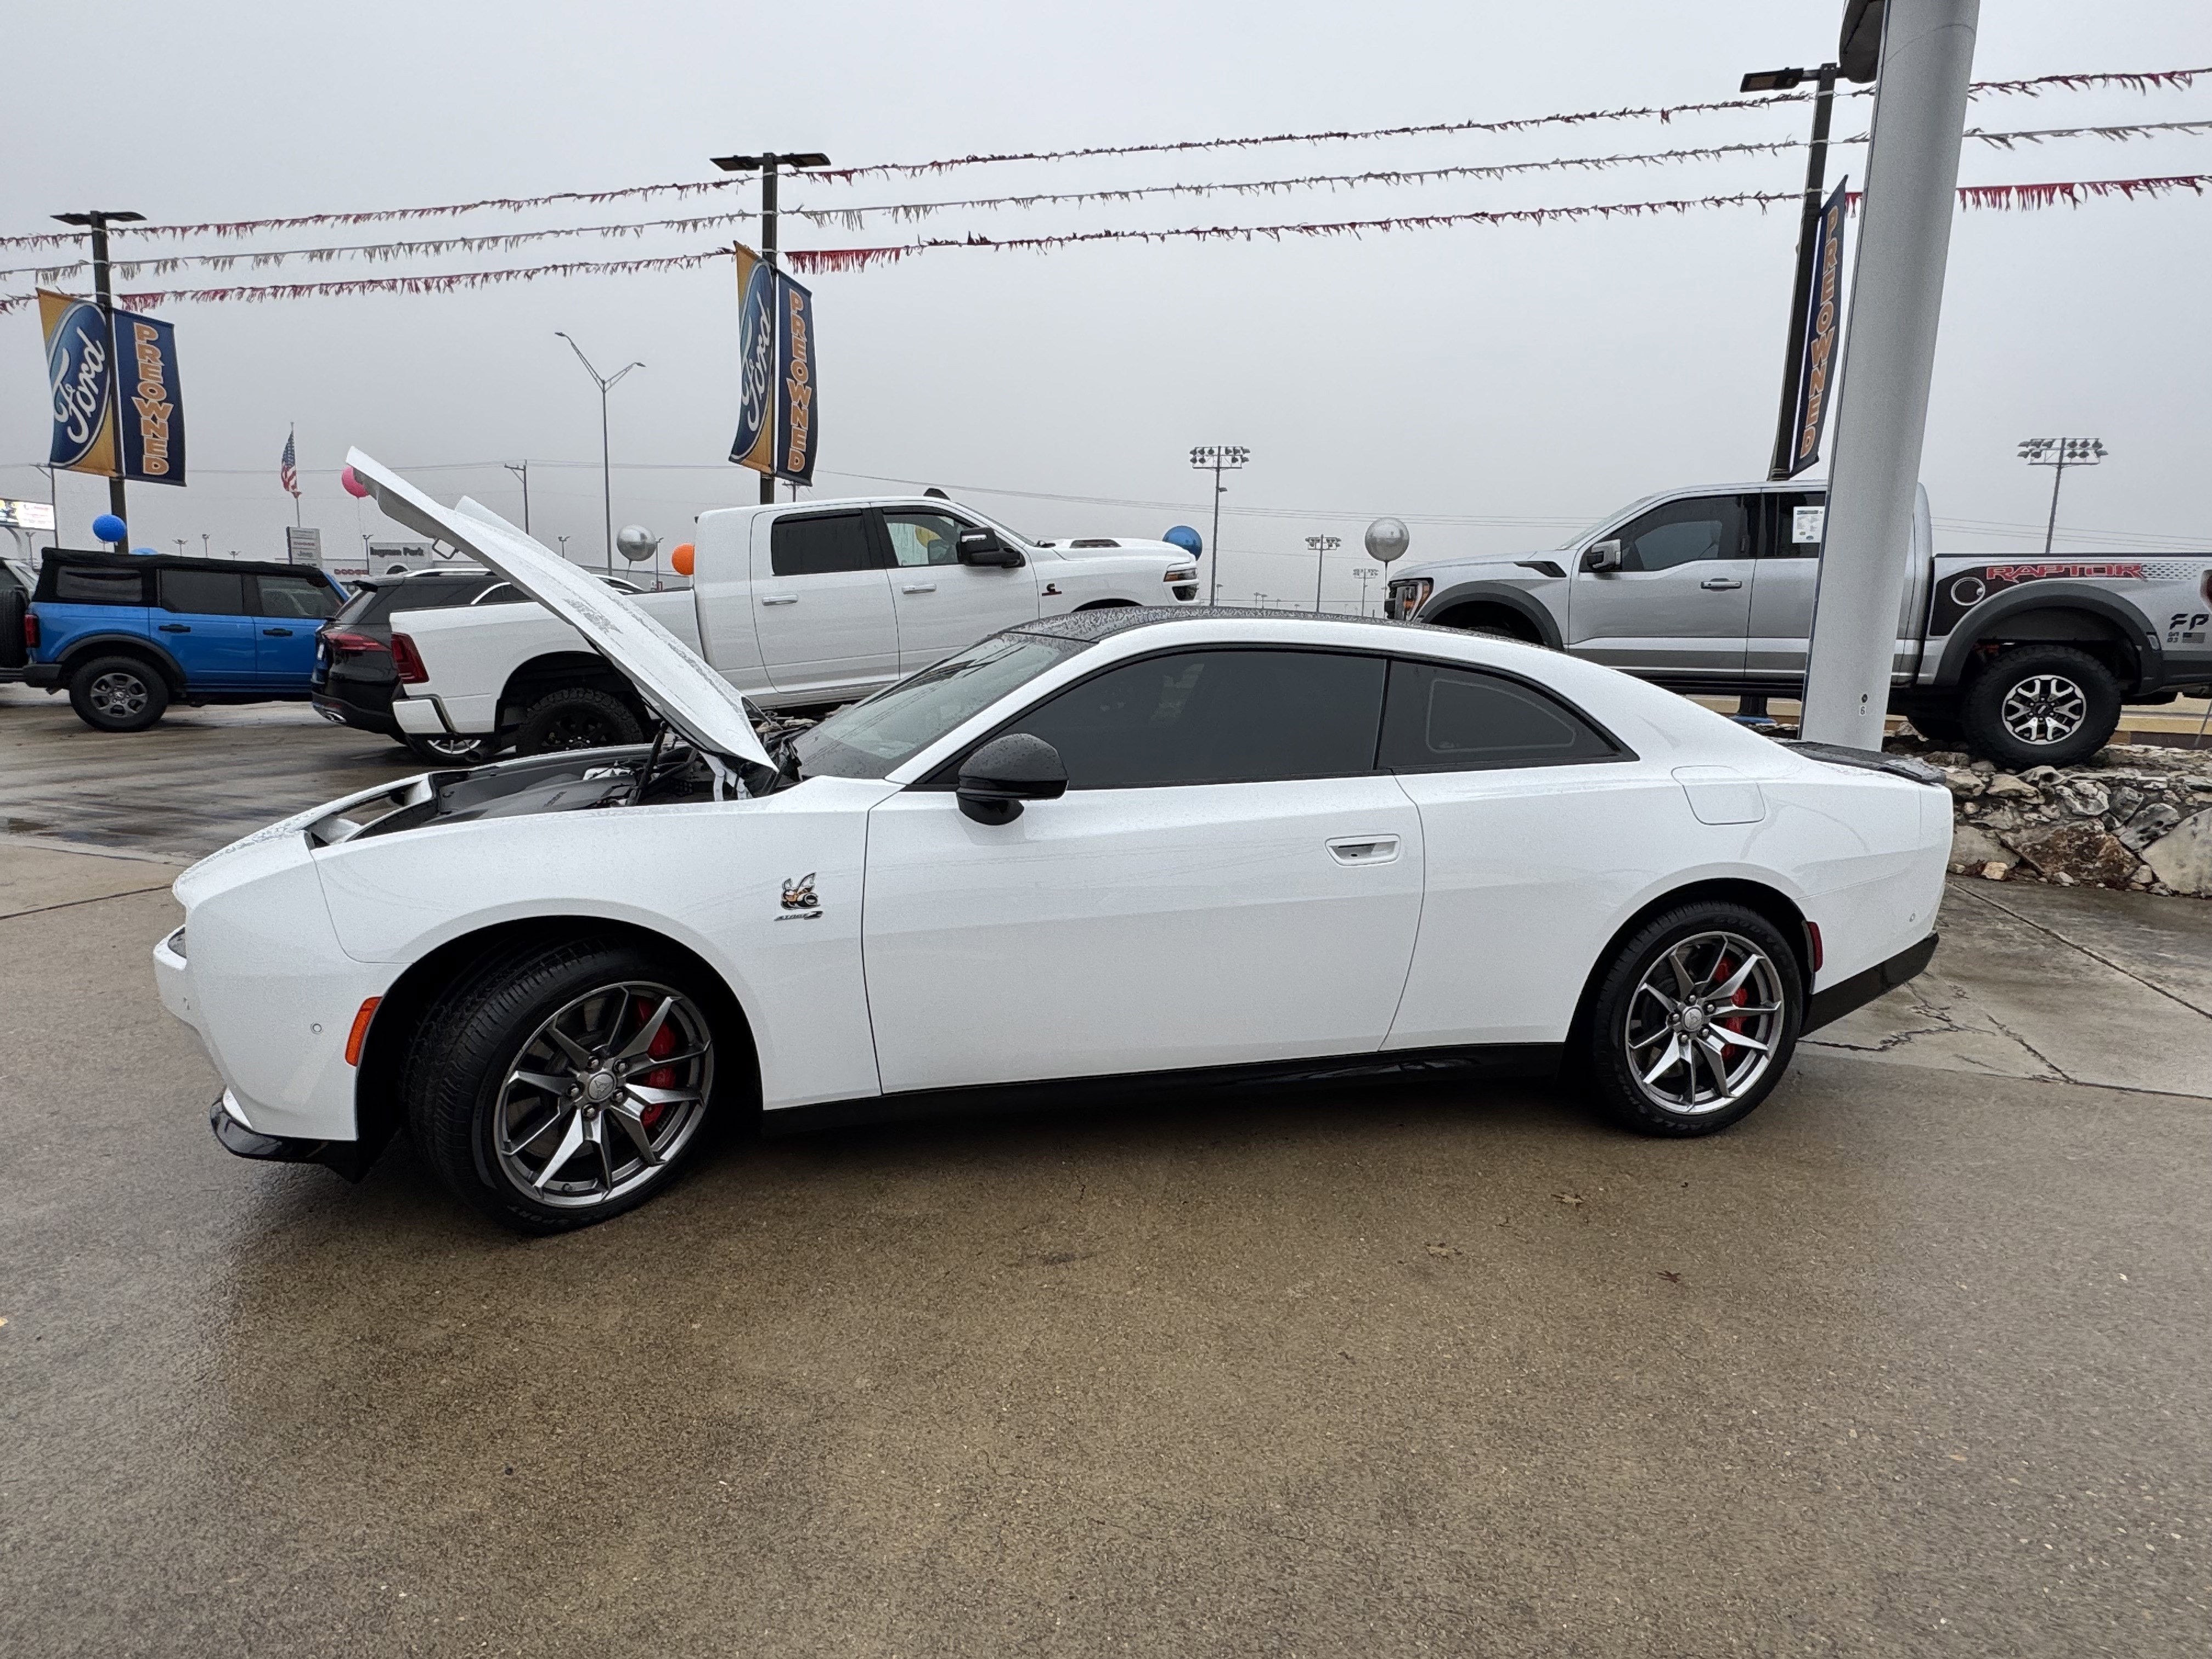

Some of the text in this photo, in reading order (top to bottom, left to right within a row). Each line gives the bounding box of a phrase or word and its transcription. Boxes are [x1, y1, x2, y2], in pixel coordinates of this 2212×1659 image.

[54, 326, 105, 443] Ford
[132, 322, 173, 475] PREOWNED
[741, 291, 771, 432] Ford
[786, 289, 812, 472] PREOWNED
[1799, 205, 1839, 459] PREOWNED
[1986, 563, 2148, 584] RAPTOR
[2169, 613, 2210, 631] FP
